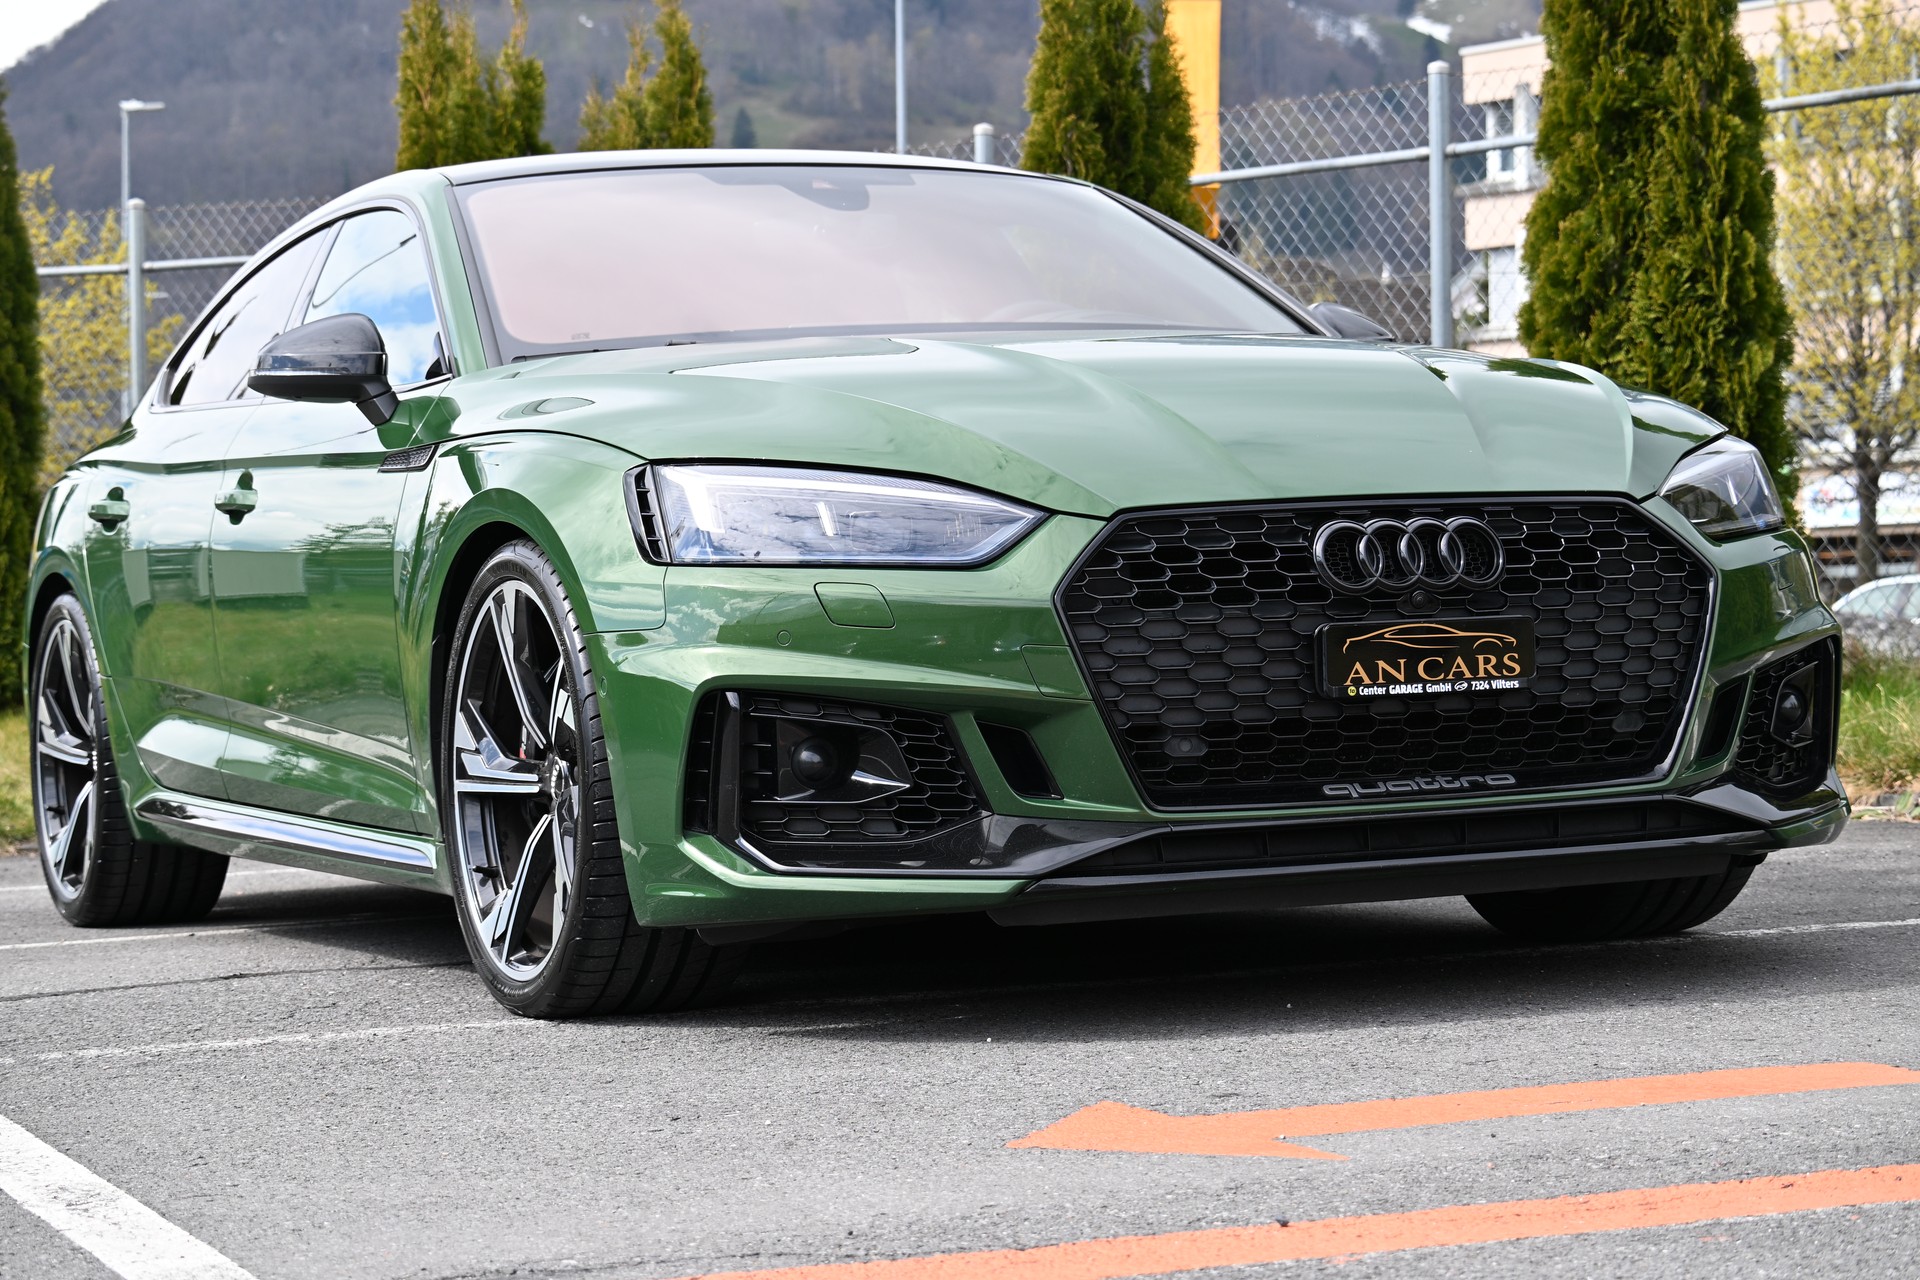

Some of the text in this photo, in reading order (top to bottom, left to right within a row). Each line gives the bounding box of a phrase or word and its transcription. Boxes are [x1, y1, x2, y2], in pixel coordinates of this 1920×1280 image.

[1344, 653, 1521, 685] AN CARS
[1359, 685, 1387, 696] Center
[1389, 684, 1424, 695] GARAGE
[1426, 682, 1452, 693] GmbH
[1471, 681, 1490, 690] 7324
[1491, 679, 1519, 690] Vilters
[1322, 773, 1516, 798] quattro
